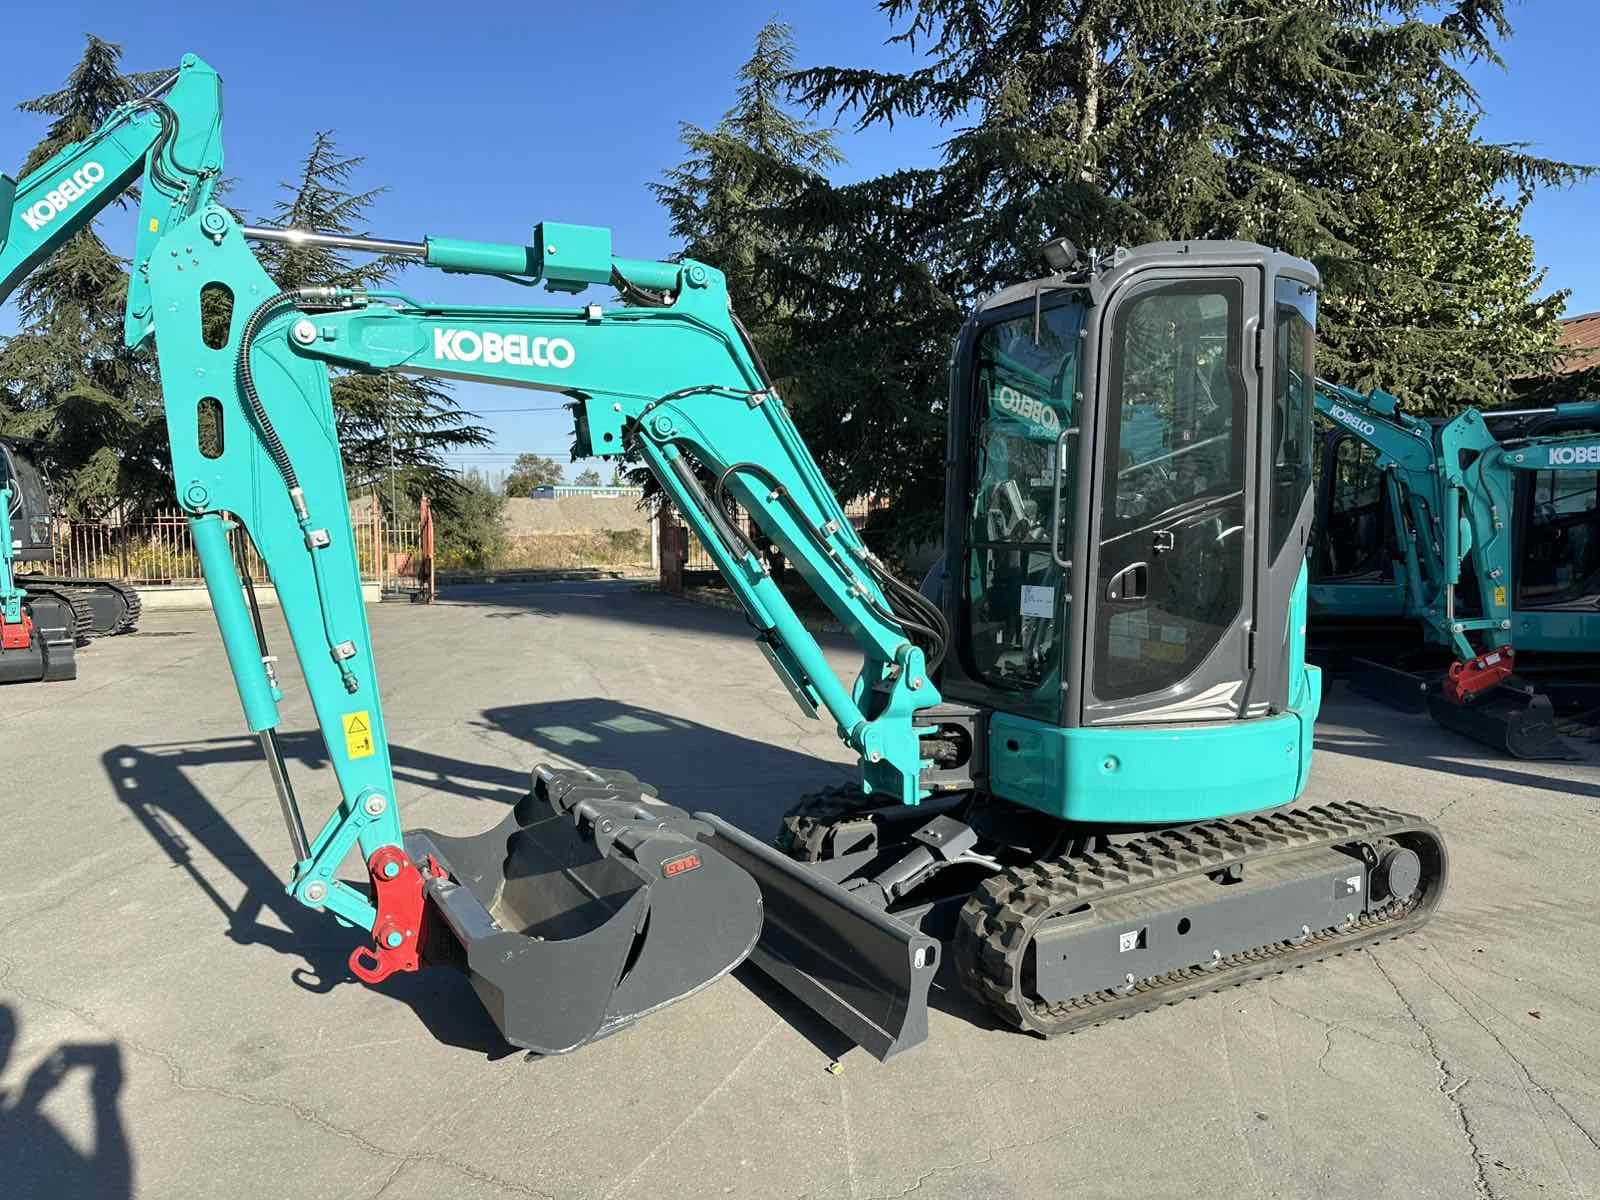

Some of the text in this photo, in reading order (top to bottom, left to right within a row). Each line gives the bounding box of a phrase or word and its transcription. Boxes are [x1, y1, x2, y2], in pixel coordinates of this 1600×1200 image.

[21, 161, 105, 232] KOBELCO
[434, 328, 576, 369] KOBELCO
[1329, 404, 1375, 435] KOBELCO
